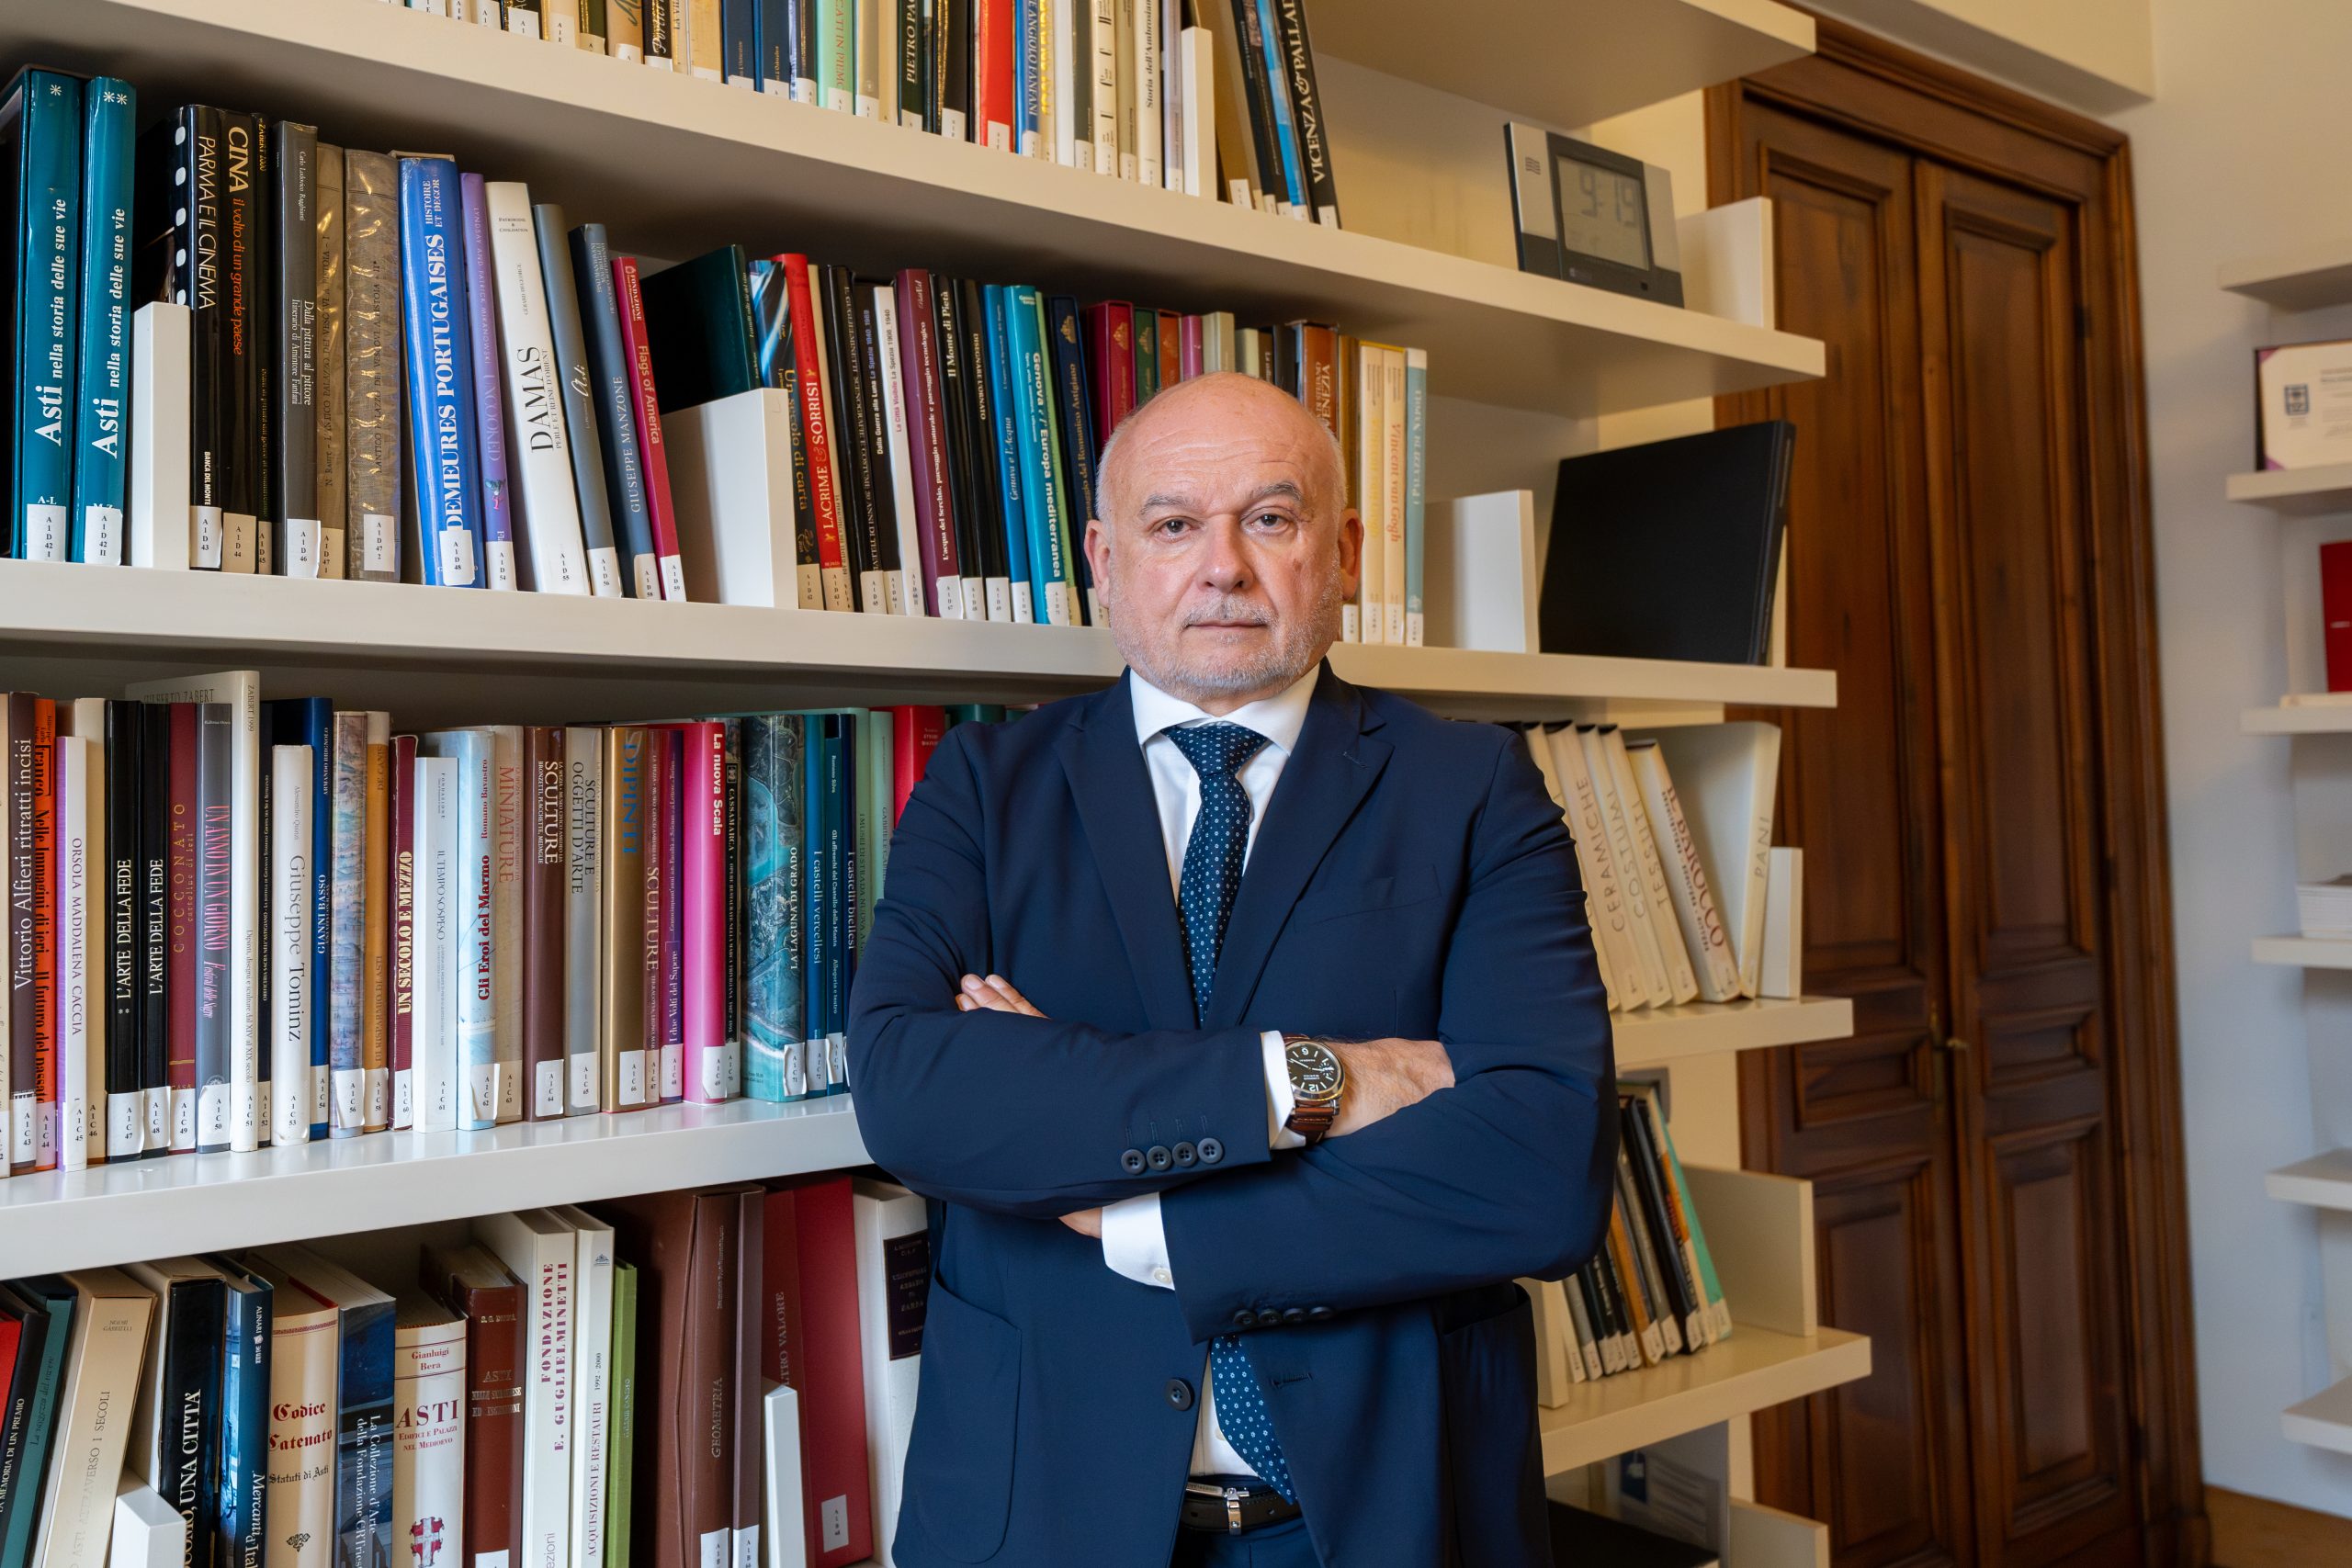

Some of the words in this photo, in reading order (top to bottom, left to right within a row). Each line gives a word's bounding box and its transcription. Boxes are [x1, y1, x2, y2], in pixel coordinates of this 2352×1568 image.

[906, 26, 915, 84] PIETRO
[1028, 10, 1036, 63] ANGIOLO
[1028, 66, 1037, 116] FANFANI
[229, 127, 249, 192] CINA
[1294, 96, 1326, 184] VICENZA
[198, 136, 216, 199] PARMA
[52, 199, 66, 220] vie
[115, 209, 125, 229] vie
[198, 205, 216, 214] E
[198, 218, 216, 227] IL
[232, 208, 244, 238] volto
[55, 226, 65, 251] sue
[113, 235, 123, 260] sue
[233, 240, 244, 253] di
[51, 255, 65, 289] delle
[109, 265, 122, 299] delle
[198, 233, 216, 309] CINEMA
[233, 254, 243, 271] un
[232, 273, 244, 316] grande
[302, 301, 313, 324] Dalla
[940, 291, 951, 317] Pietà
[51, 296, 63, 337] storia
[107, 306, 120, 346] storia
[425, 234, 454, 397] PORTUGAISES
[944, 319, 953, 327] di
[231, 319, 243, 355] paese
[301, 327, 314, 359] pittura
[945, 329, 955, 367] Monte
[49, 344, 62, 378] nella
[107, 353, 119, 388] nella
[302, 363, 313, 371] al
[638, 345, 650, 376] Flags
[947, 368, 956, 378] Il
[301, 375, 313, 405] pittore
[517, 346, 554, 453] DAMAS
[643, 378, 652, 392] of
[34, 386, 62, 447] Asti
[91, 399, 119, 458] Asti
[612, 376, 631, 443] MANZONE
[645, 395, 661, 445] America
[807, 381, 824, 445] SORRISI
[436, 405, 463, 531] DEMEURES
[623, 448, 641, 513] GIUSEPPE
[1033, 352, 1046, 405] Genova
[1046, 482, 1062, 578] mediterranea
[816, 467, 834, 529] LACRIME
[14, 739, 31, 785] incisi
[713, 734, 723, 749] La
[713, 754, 723, 794] nuova
[205, 805, 230, 822] UN
[544, 761, 559, 863] SCULTURE
[571, 761, 583, 829] OGGETTI
[622, 743, 638, 853] DIPINTI
[13, 791, 32, 849] ritratti
[499, 766, 514, 883] MINIATURE
[584, 780, 595, 860] SCULTURE
[713, 799, 723, 836] Scala
[728, 788, 736, 852] CASSAMARCA
[204, 825, 230, 860] ANNO
[437, 850, 446, 860] IL
[1576, 776, 1626, 932] CERAMICHE
[1606, 789, 1647, 919] COSTUMI
[1632, 799, 1668, 908] TESSUTI
[1754, 816, 1770, 879] PANI
[13, 855, 32, 911] Alfieri
[72, 839, 82, 889] ORSOLA
[117, 859, 131, 895] FEDE
[149, 859, 164, 894] FEDE
[204, 863, 230, 876] IN
[398, 852, 413, 908] MEZZO
[436, 860, 446, 895] TEMPO
[478, 855, 491, 909] Marmo
[571, 836, 584, 894] D'ARTE
[584, 867, 595, 875] E
[1678, 819, 1725, 948] BAROCCO
[204, 881, 229, 898] UN
[284, 855, 306, 955] Giuseppe
[317, 874, 326, 910] BASSO
[790, 892, 797, 901] DI
[117, 898, 132, 943] DELLA
[149, 898, 164, 942] DELLA
[203, 902, 229, 951] GIORNO
[317, 913, 326, 954] GIANNI
[398, 911, 412, 921] E
[436, 897, 446, 941] SOSPESO
[478, 912, 491, 936] del
[646, 866, 660, 971] SCULTURE
[14, 914, 33, 990] Vittorio
[72, 897, 83, 978] MADDALENA
[398, 926, 412, 987] SECOLO
[478, 940, 491, 974] Eroi
[117, 951, 132, 999] L'ARTE
[149, 946, 164, 994] L'ARTE
[670, 951, 680, 979] Sapere
[790, 955, 797, 969] LA
[288, 963, 306, 1042] Tominz
[398, 991, 412, 1015] UN
[478, 977, 491, 1000] Gli
[669, 982, 679, 997] del
[670, 998, 678, 1017] Volti
[72, 986, 83, 1035] CACCIA
[670, 1018, 678, 1034] due
[540, 1263, 554, 1382] FONDAZIONE
[412, 1348, 449, 1359] Gianluigi
[555, 1262, 567, 1425] GUGLIELMINETTI
[420, 1361, 441, 1371] Bera
[274, 1403, 325, 1422] Codice
[356, 1418, 368, 1443] della
[369, 1416, 381, 1427] La
[396, 1399, 459, 1428] ASTI
[591, 1403, 602, 1461] RESTAURI
[711, 1378, 723, 1460] GEOMETRIA
[554, 1434, 565, 1450] E.
[180, 1457, 198, 1505] UNA
[304, 1471, 311, 1480] di
[312, 1466, 329, 1481] Asti
[356, 1447, 368, 1516] Fondazione
[370, 1432, 381, 1497] Collezione
[251, 1473, 265, 1536] Mercanti
[369, 1500, 381, 1534] d'Arte
[588, 1474, 600, 1557] ACQUISIZIONI
